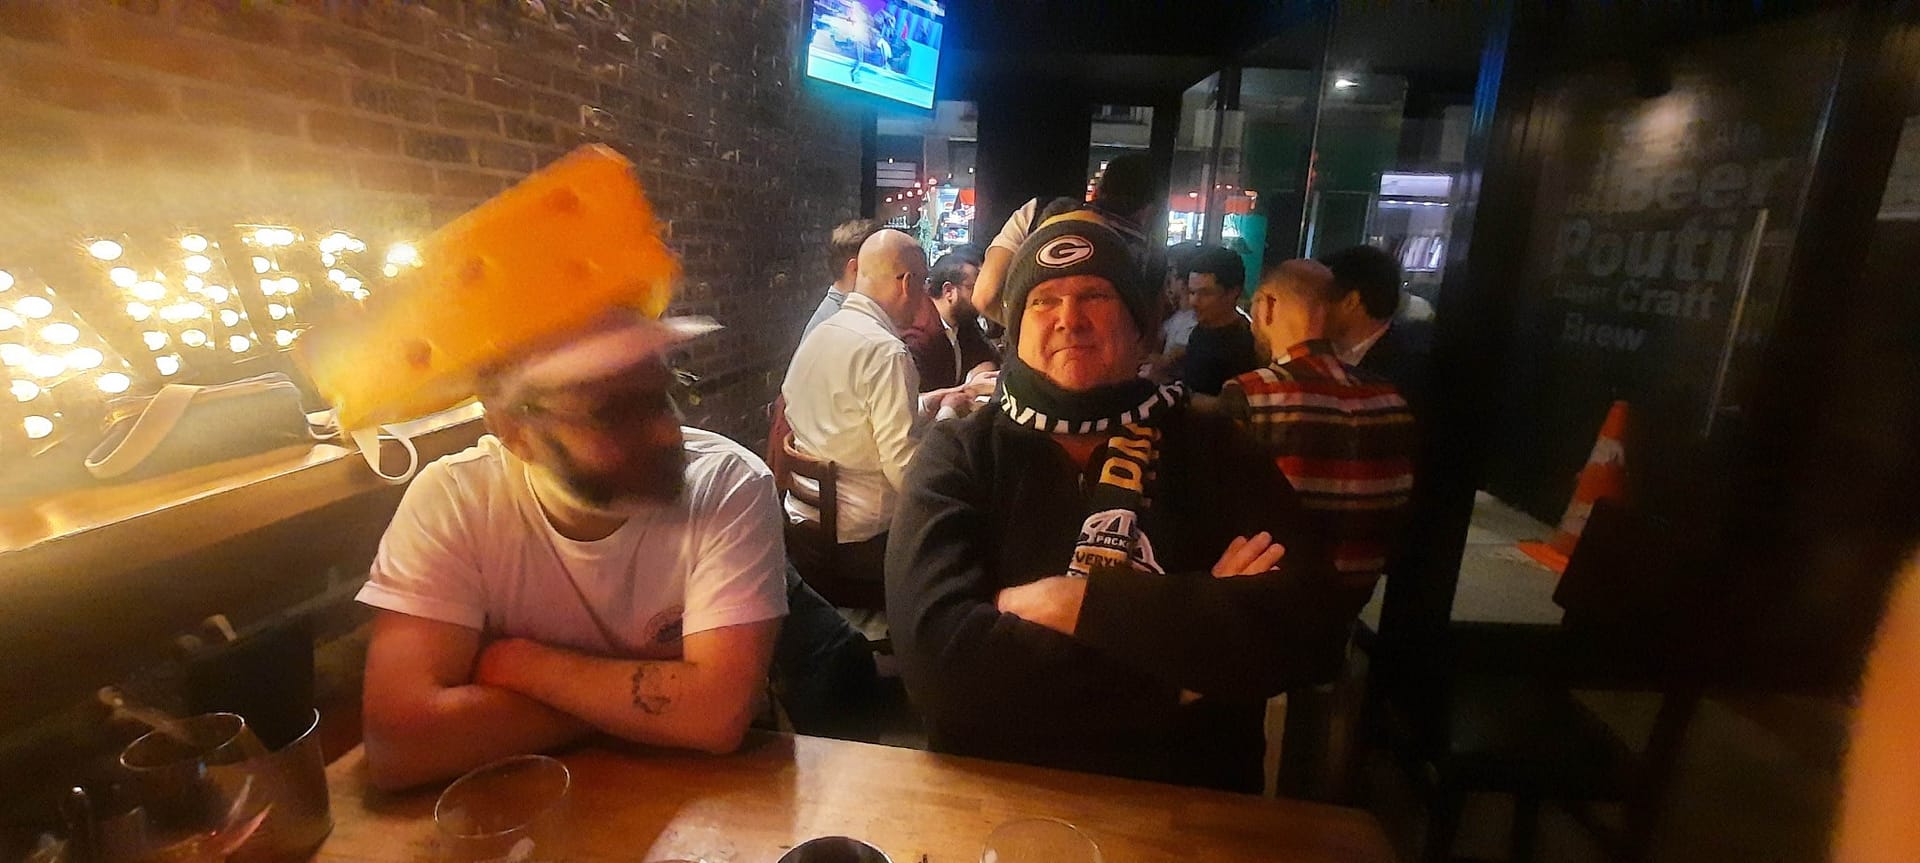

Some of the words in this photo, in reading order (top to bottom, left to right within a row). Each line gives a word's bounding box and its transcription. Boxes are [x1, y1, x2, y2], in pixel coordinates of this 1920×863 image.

[1037, 235, 1094, 269] G
[1616, 279, 1719, 321] Craft
[1562, 311, 1647, 352] Brew
